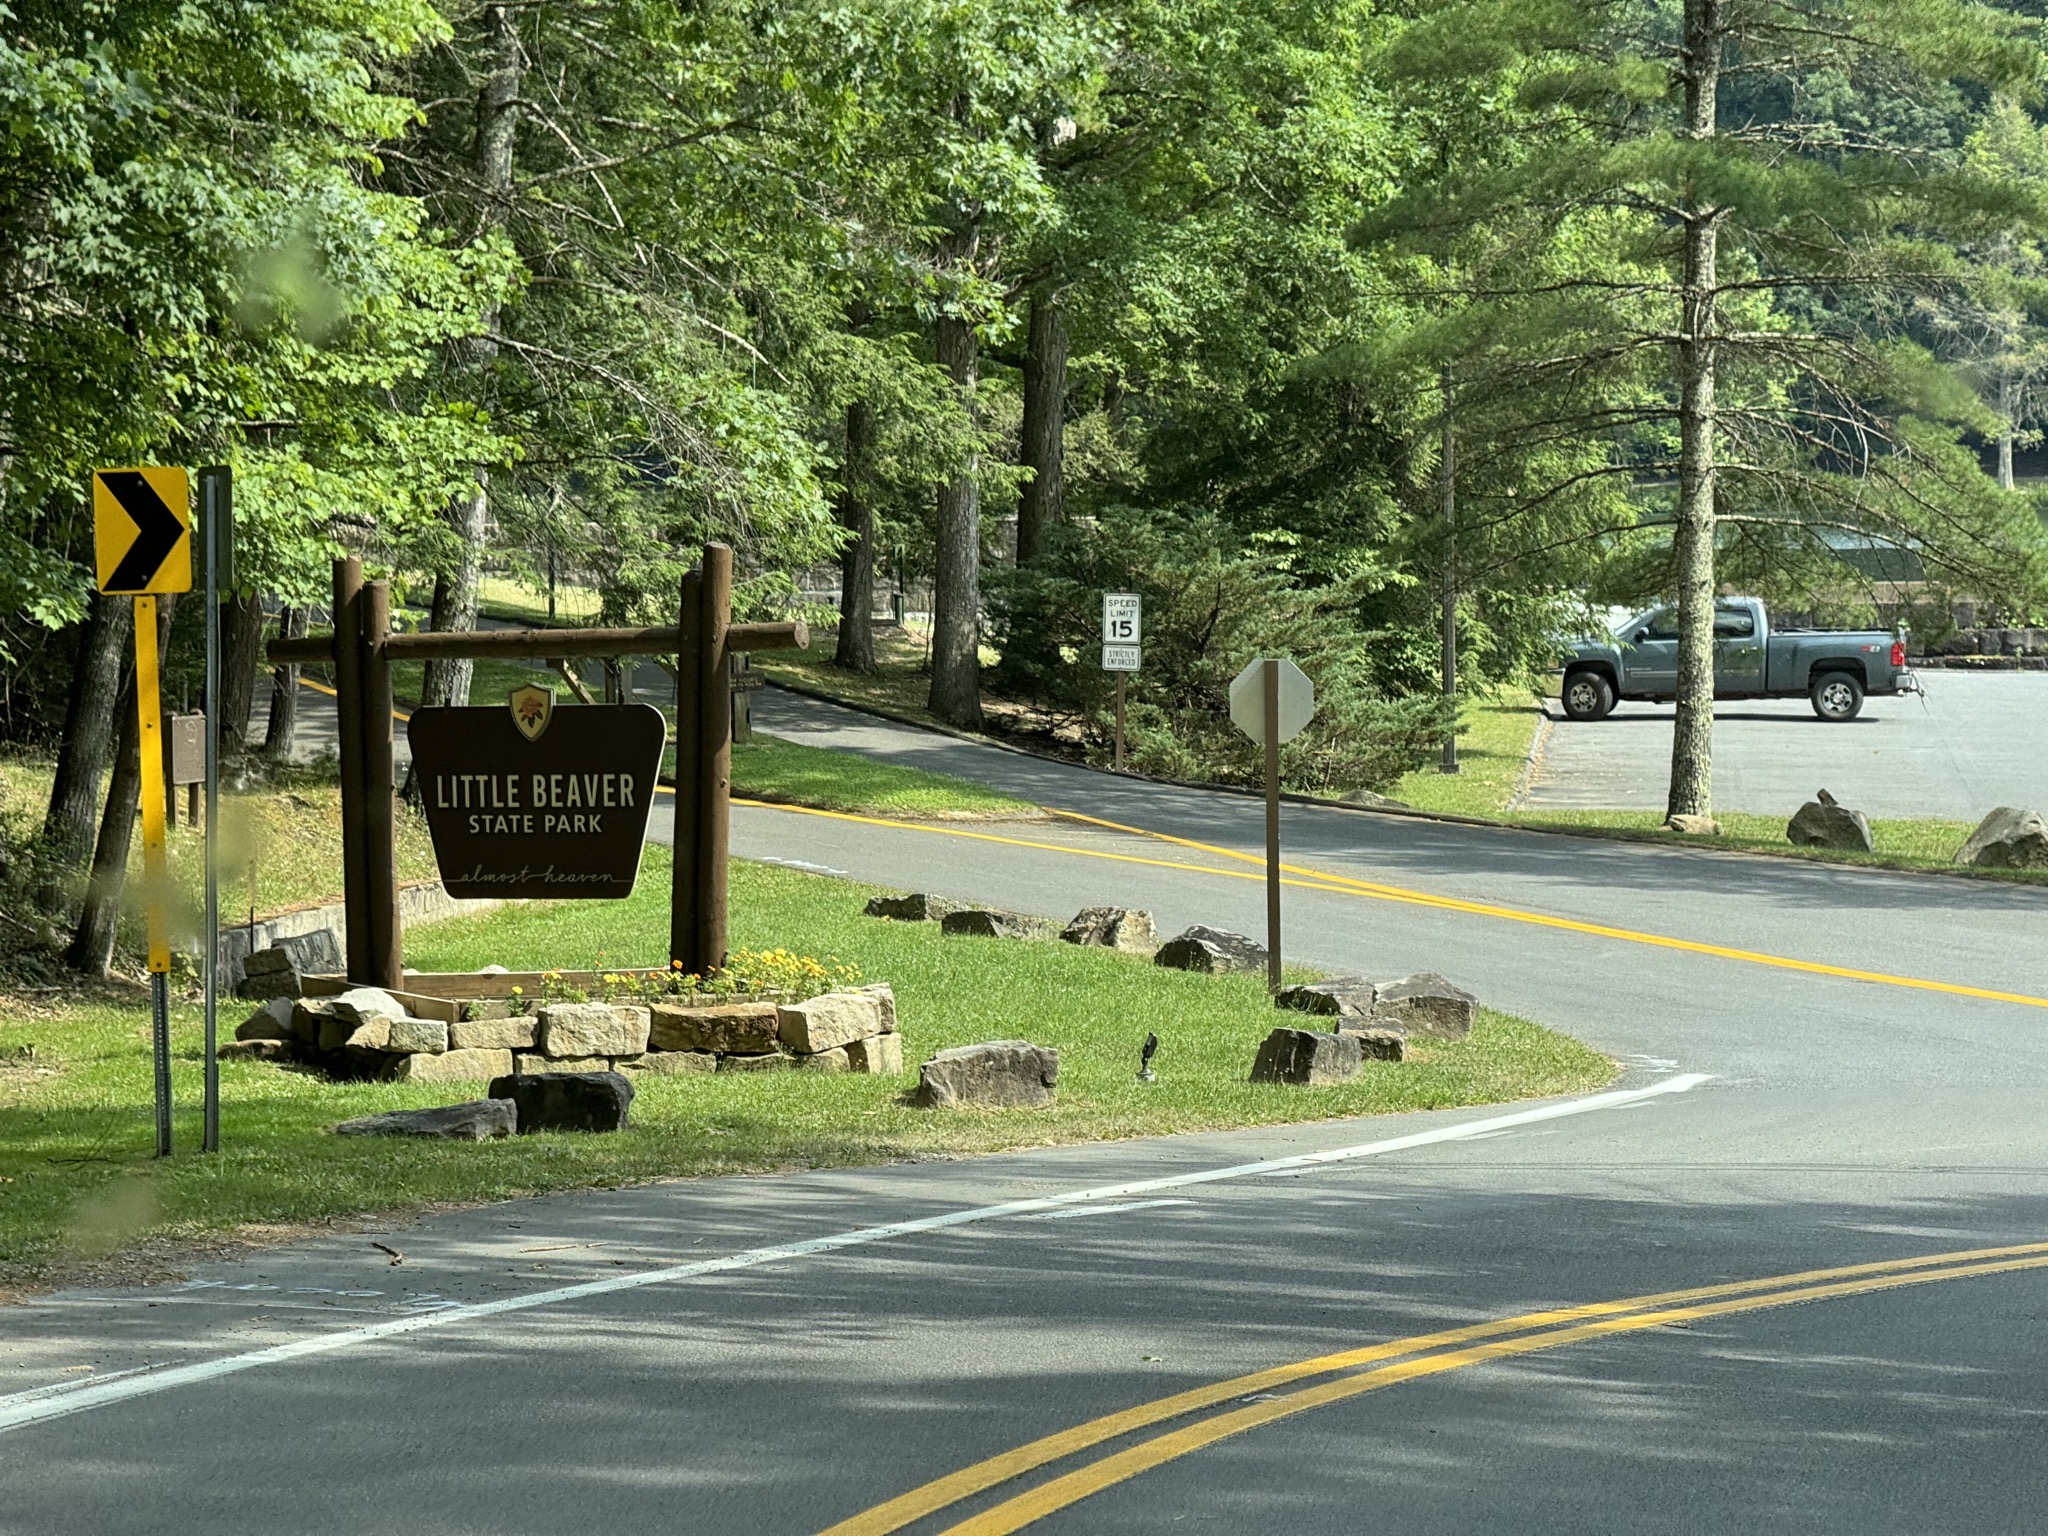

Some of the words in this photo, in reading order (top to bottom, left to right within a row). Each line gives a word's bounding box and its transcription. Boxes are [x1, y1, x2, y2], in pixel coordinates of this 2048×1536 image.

[1111, 620, 1133, 638] 15
[1107, 658, 1136, 666] ENFORCED
[1108, 650, 1135, 658] STRICTLY
[437, 775, 520, 808] LITTLE
[533, 774, 635, 807] BEAVER
[469, 815, 534, 833] STATE
[544, 814, 603, 833] PARK
[460, 864, 531, 884] almost
[542, 864, 615, 883] heaven
